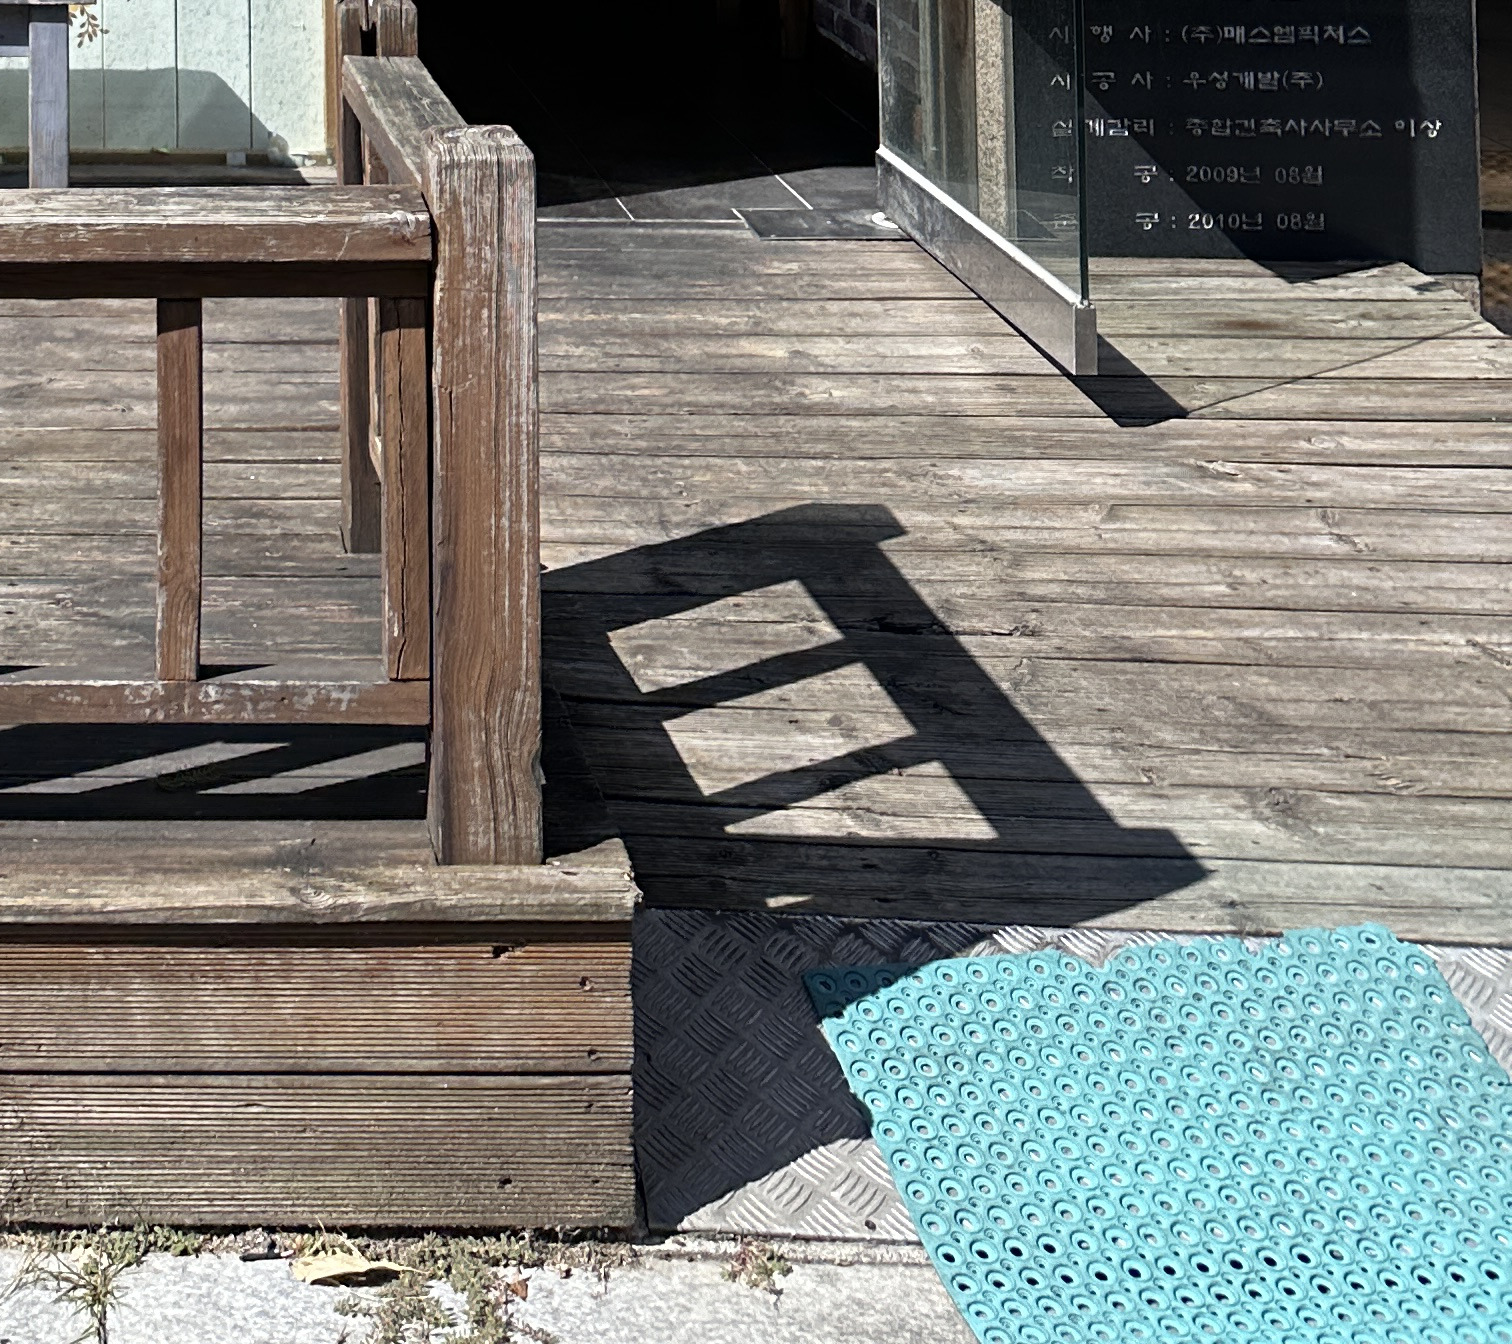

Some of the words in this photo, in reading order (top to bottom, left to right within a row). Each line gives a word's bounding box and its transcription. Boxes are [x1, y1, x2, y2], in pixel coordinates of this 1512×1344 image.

[1182, 70, 1325, 92] 우성개발(주)
[1184, 117, 1383, 139] 종합건축사사무소
[1393, 117, 1442, 139] 이상
[1185, 164, 1262, 185] 2009년
[1274, 164, 1324, 185] 08월
[1187, 212, 1264, 232] 2010년
[1276, 212, 1326, 232] 08월
